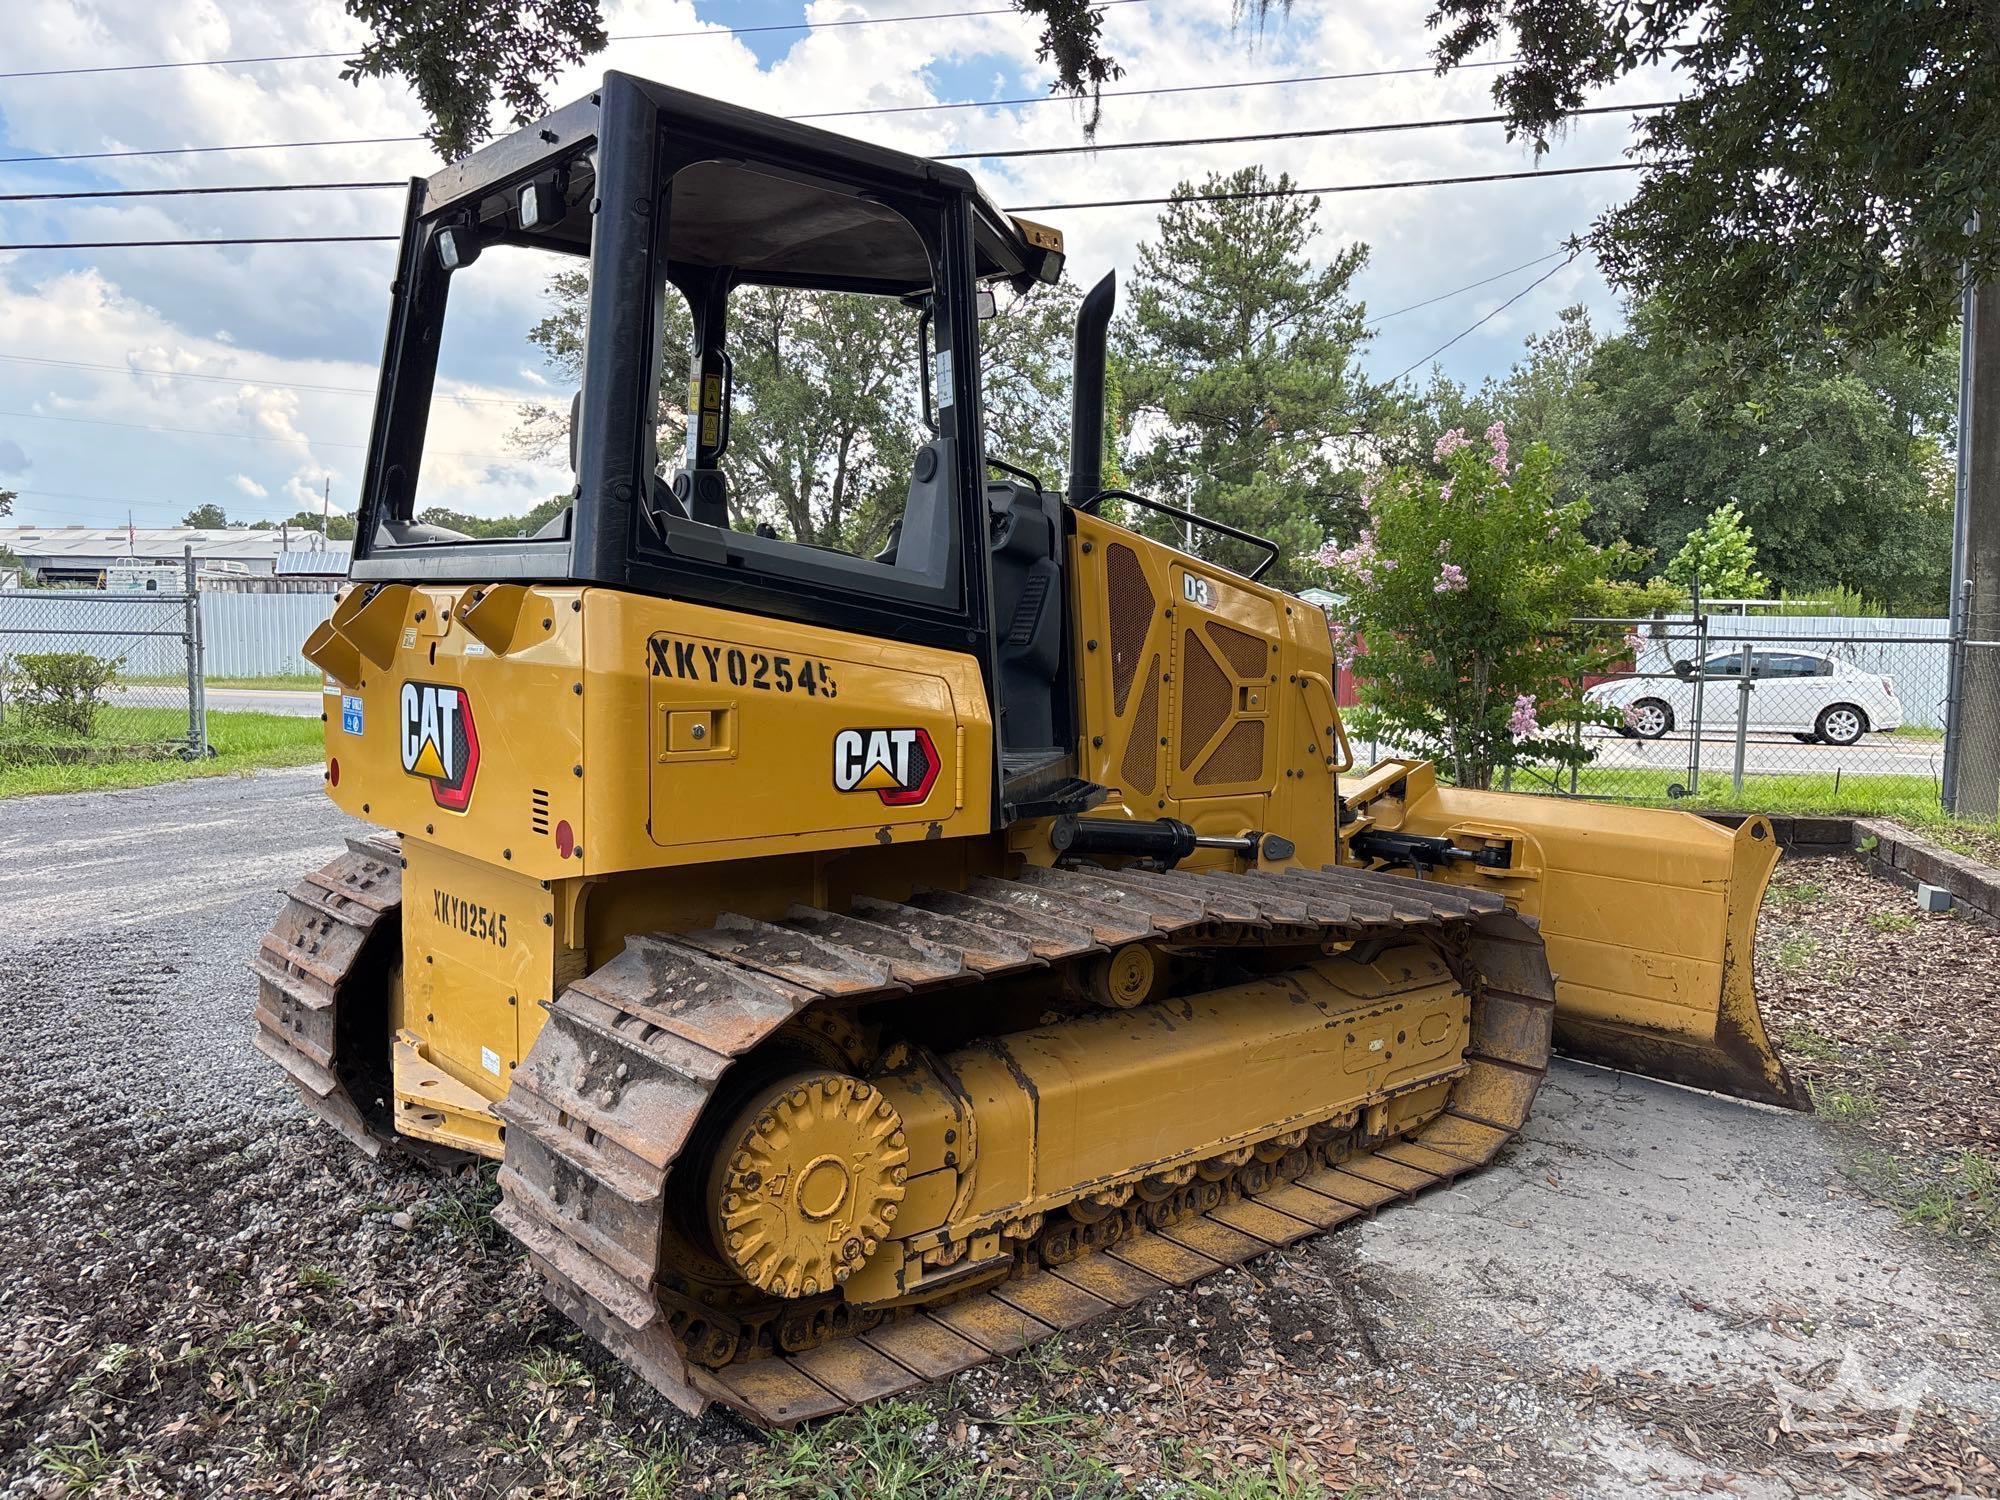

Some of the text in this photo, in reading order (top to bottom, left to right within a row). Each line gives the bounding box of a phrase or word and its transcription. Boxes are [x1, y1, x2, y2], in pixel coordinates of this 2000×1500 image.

[1183, 572, 1208, 606] D3
[650, 638, 838, 699] XKY02545
[401, 683, 458, 781] CAT
[835, 730, 916, 791] CAT
[433, 888, 507, 949] XKY02545
